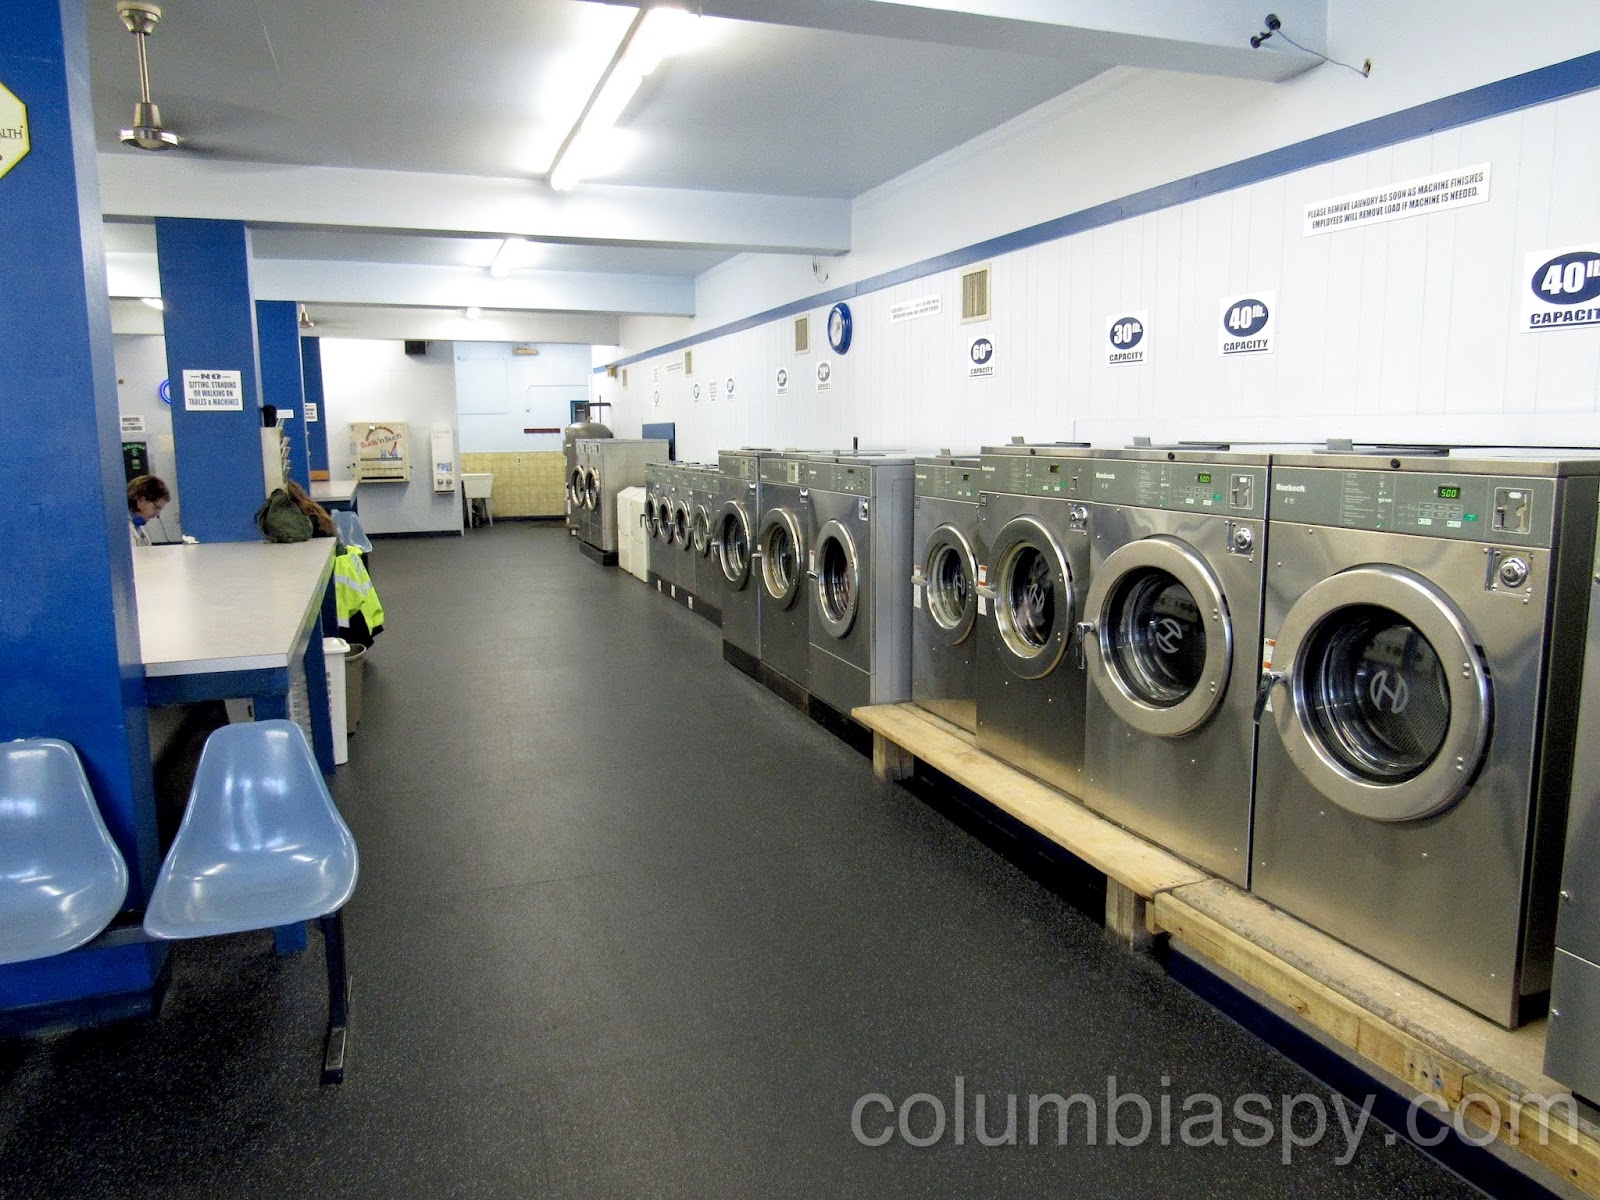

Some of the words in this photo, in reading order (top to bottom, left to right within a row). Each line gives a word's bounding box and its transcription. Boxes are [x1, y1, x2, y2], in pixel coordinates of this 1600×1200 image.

[1308, 207, 1326, 219] PLEASE
[1327, 202, 1350, 214] REMOVE
[1351, 196, 1378, 209] LAUNDRY
[1379, 194, 1387, 203] AS
[1388, 189, 1407, 202] SOON
[1408, 187, 1416, 197] AS
[1418, 180, 1449, 195] MACHINE
[1450, 172, 1483, 188] FINISHES
[1312, 215, 1342, 229] EMPLOYEES
[1344, 212, 1357, 222] WILL
[1359, 206, 1383, 219] REMOVE
[1385, 203, 1400, 214] LOAD
[1402, 201, 1408, 211] IF
[1409, 194, 1440, 209] MACHINE
[1441, 193, 1448, 202] IS
[1450, 187, 1478, 200] NEEDED.
[1223, 339, 1268, 351] CAPACITY
[1109, 351, 1143, 361] CAPACITY
[970, 366, 993, 374] CAPACITY
